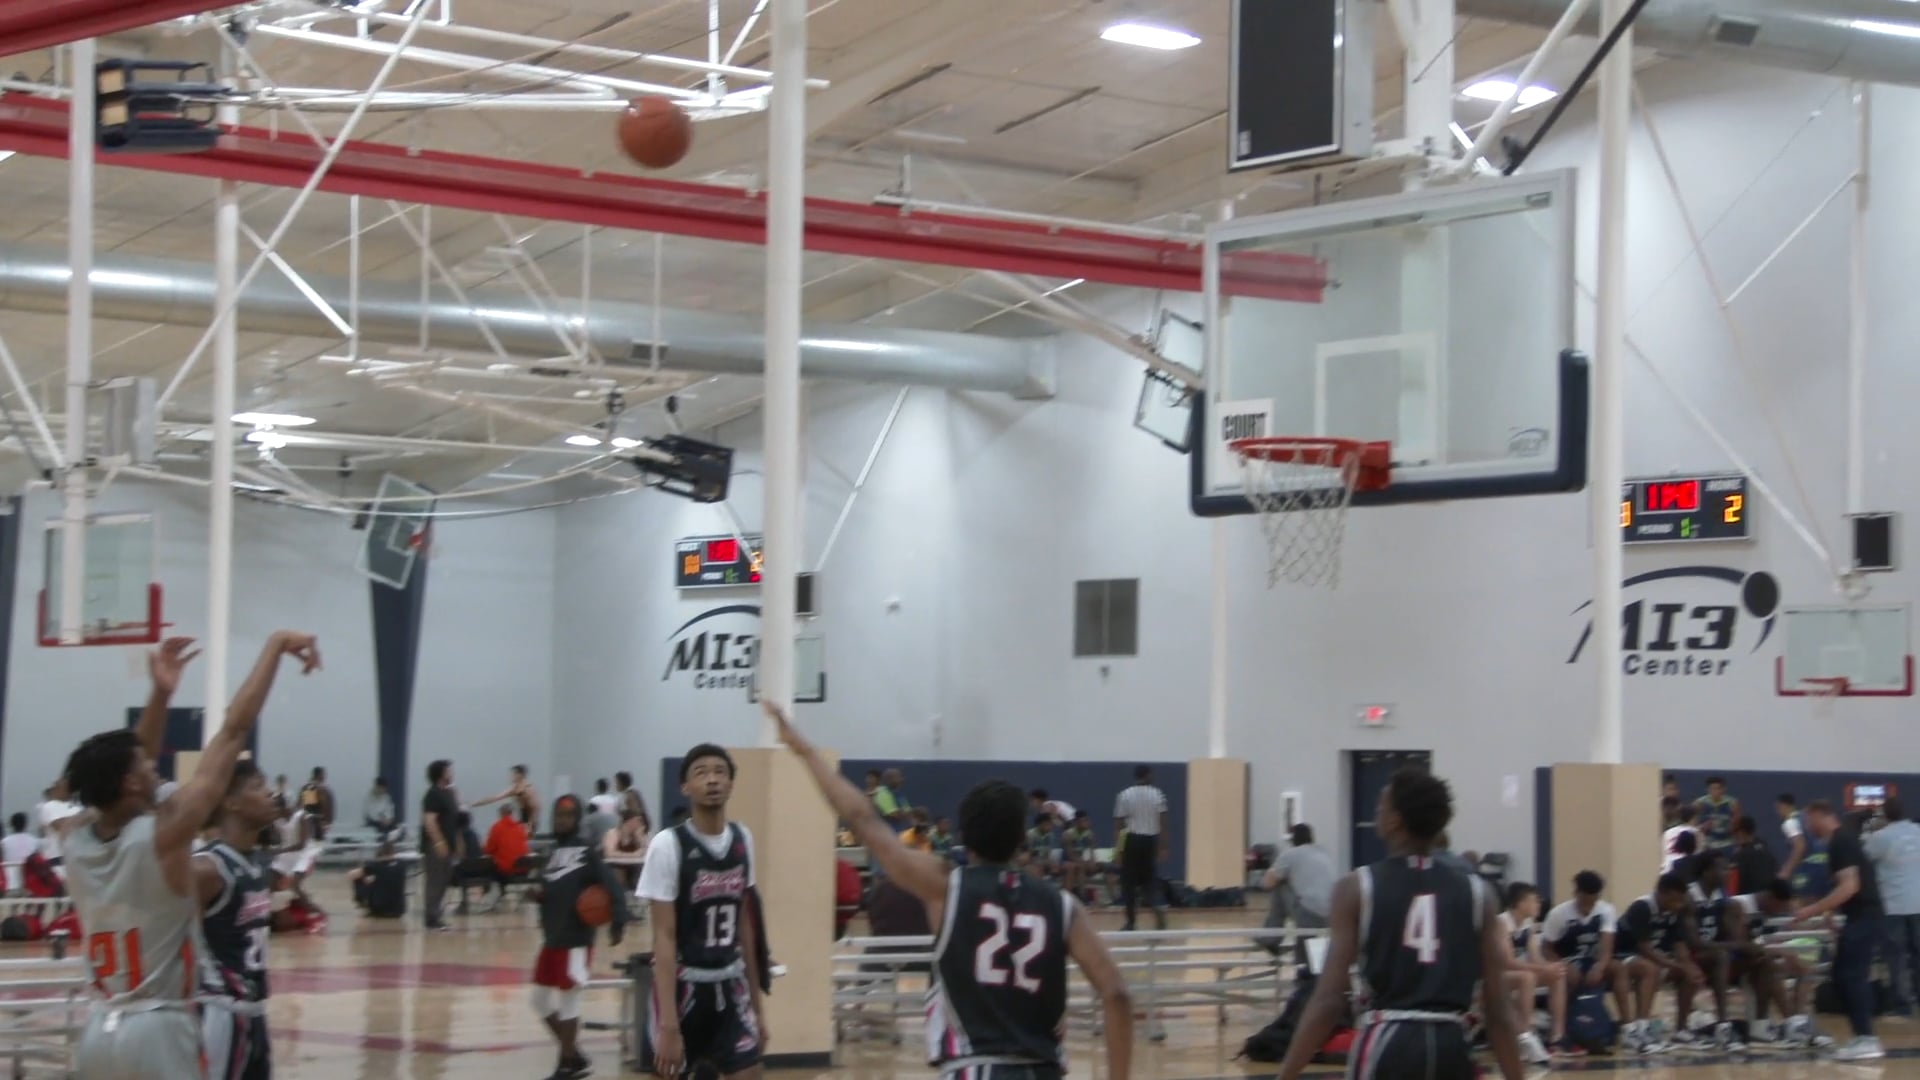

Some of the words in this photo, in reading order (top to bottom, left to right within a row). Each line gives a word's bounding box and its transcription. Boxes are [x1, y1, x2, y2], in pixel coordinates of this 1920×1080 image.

[1723, 494, 1743, 523] 2
[694, 672, 754, 689] Cente
[1623, 653, 1731, 676] Center
[705, 904, 737, 948] 13
[974, 901, 1048, 995] 22
[1402, 893, 1441, 963] 4
[89, 926, 143, 998] 21
